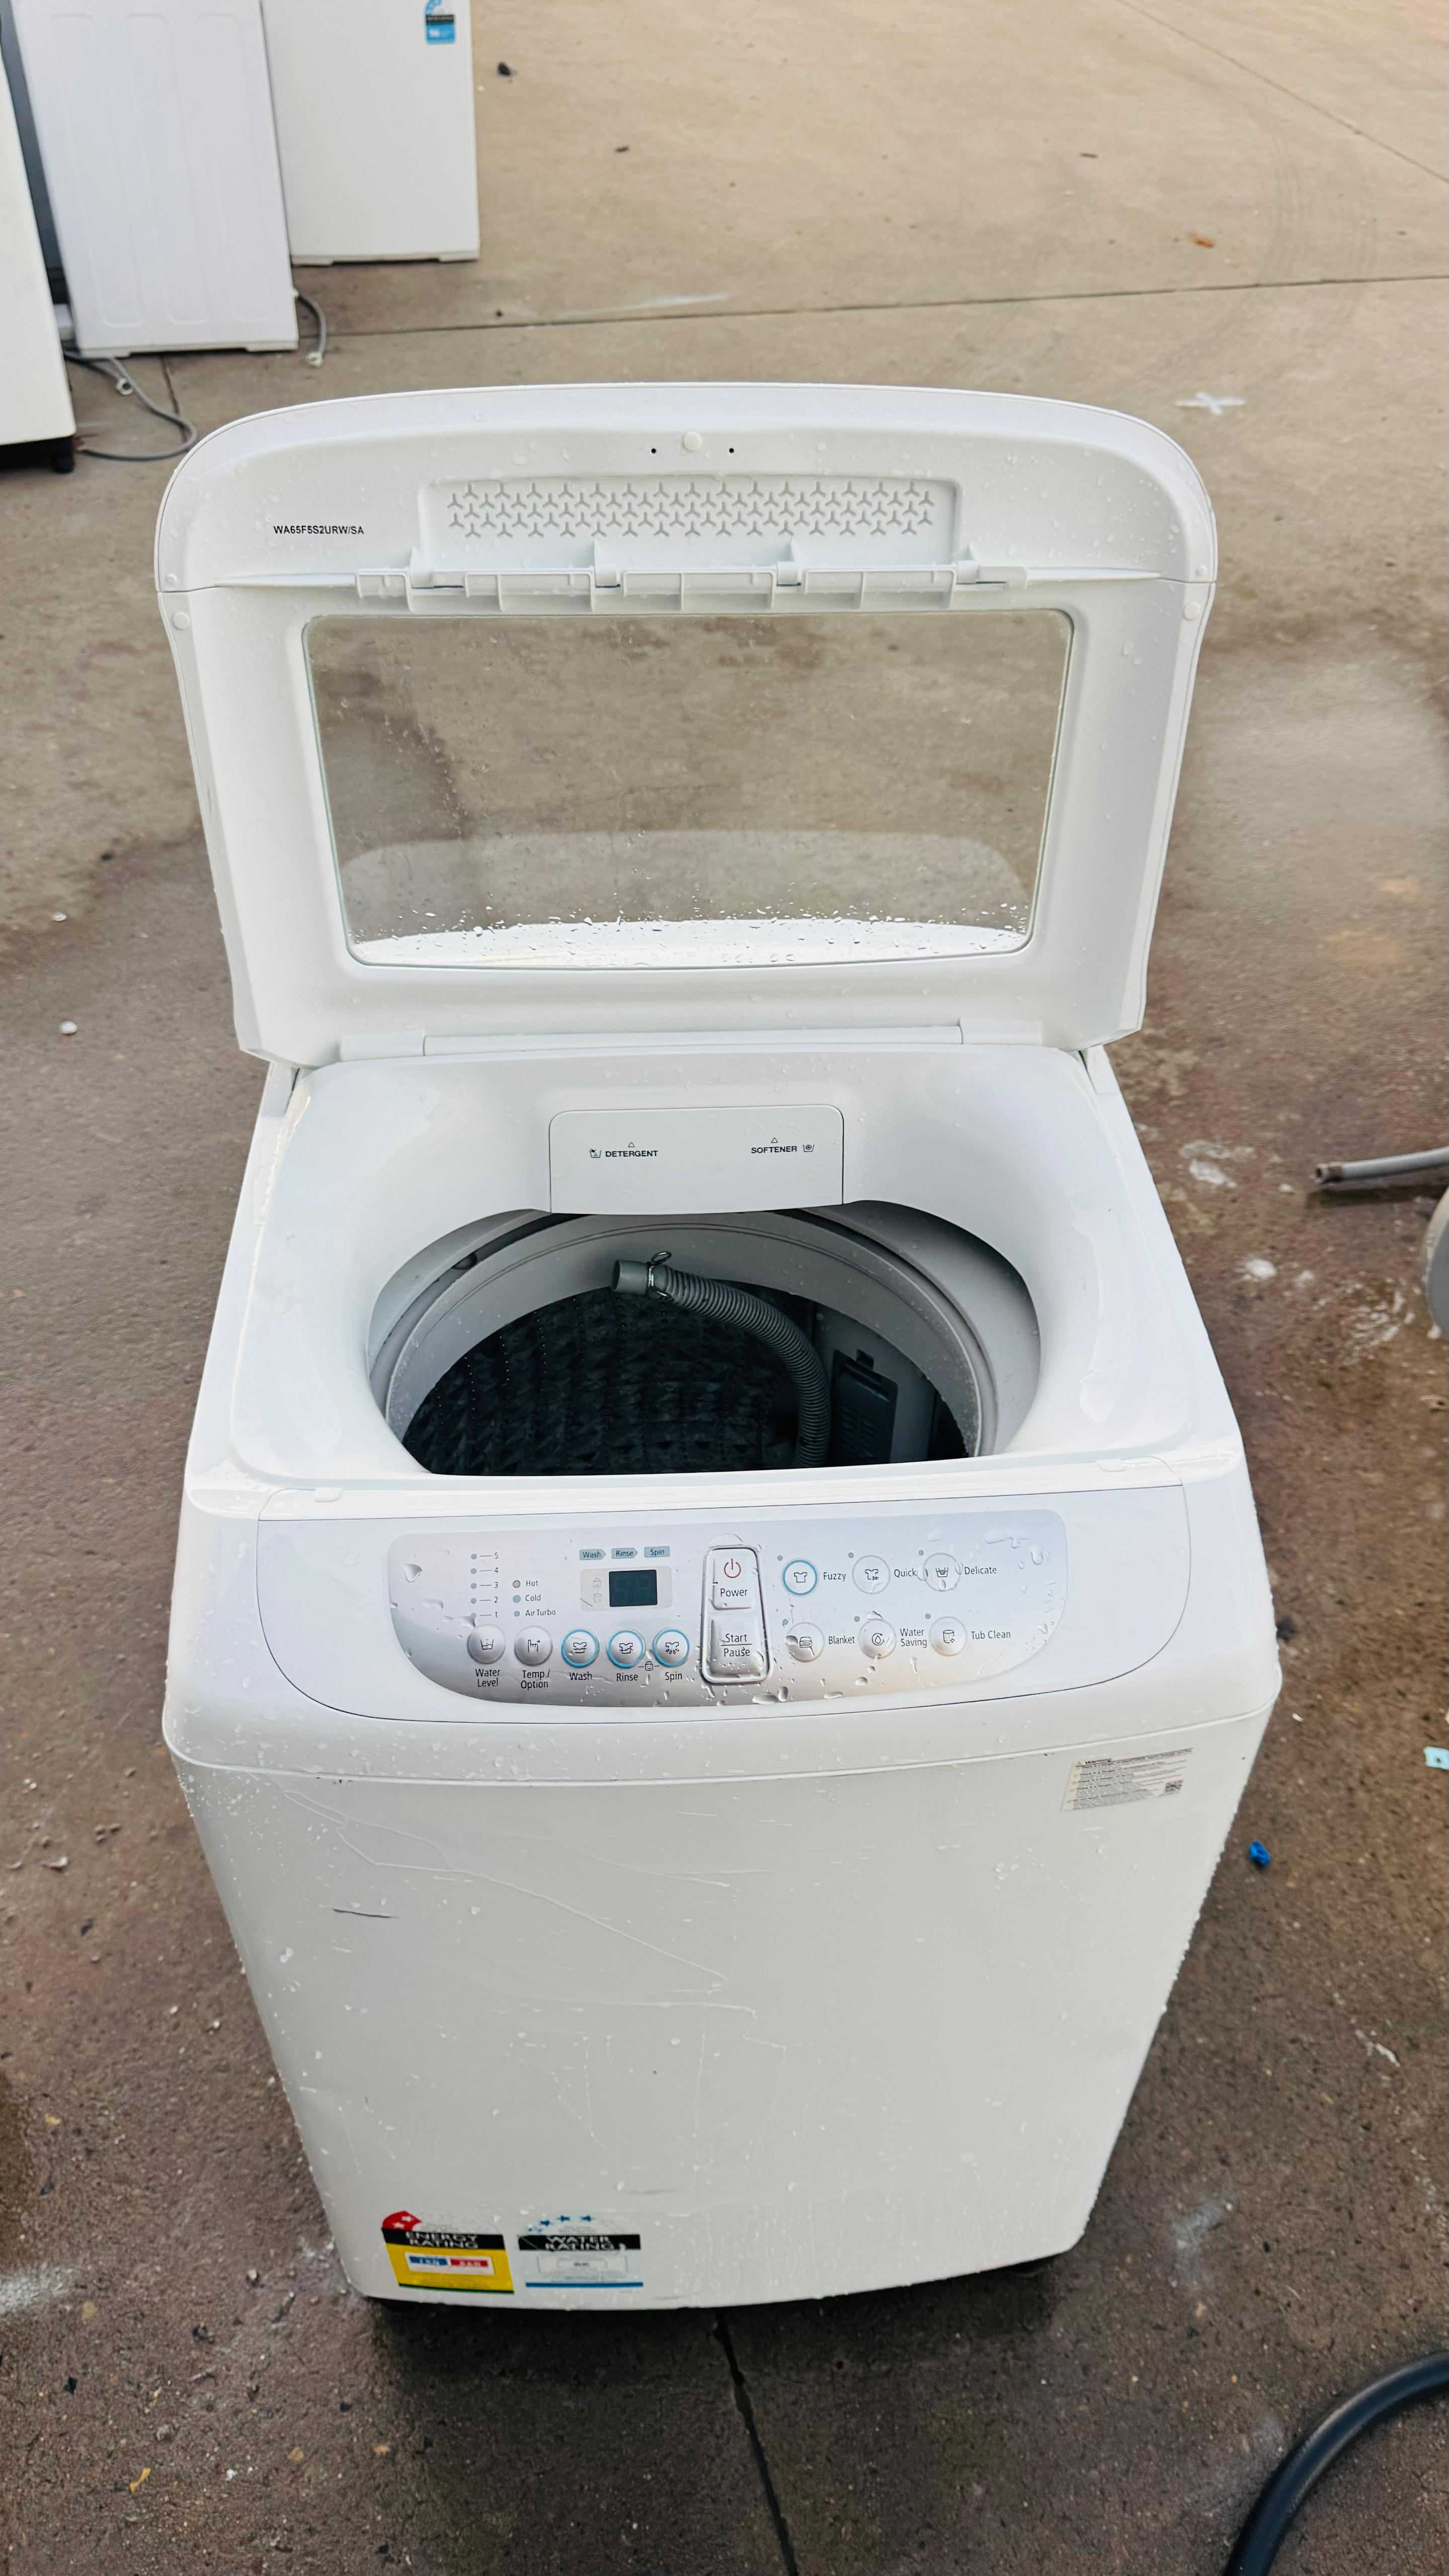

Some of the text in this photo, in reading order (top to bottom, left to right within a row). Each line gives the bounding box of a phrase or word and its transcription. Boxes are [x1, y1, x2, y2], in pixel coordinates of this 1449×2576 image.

[274, 525, 364, 535] WA65F5S2URW/SA
[751, 1146, 797, 1154] SOFTENER
[894, 1569, 917, 1578] Quick
[964, 1566, 997, 1575] Delicate
[824, 1572, 846, 1582] Fuzzy
[720, 1587, 748, 1597] Power
[900, 1628, 924, 1636] Water
[971, 1630, 1011, 1639] Tub Clean
[725, 1633, 747, 1643] Start
[829, 1636, 855, 1645] Blanket
[901, 1637, 927, 1648] Saving
[723, 1648, 750, 1657] Pause
[475, 1668, 500, 1676] Water
[522, 1669, 550, 1679] Temp./
[569, 1671, 592, 1680] Wash
[616, 1672, 638, 1681] Rinse
[665, 1671, 682, 1681] Spin
[477, 1678, 499, 1687] Level
[521, 1680, 548, 1690] Option
[405, 2231, 477, 2241] ENERGY
[546, 2235, 610, 2243] WATER
[410, 2238, 478, 2249] RATING
[545, 2242, 614, 2251] RATING
